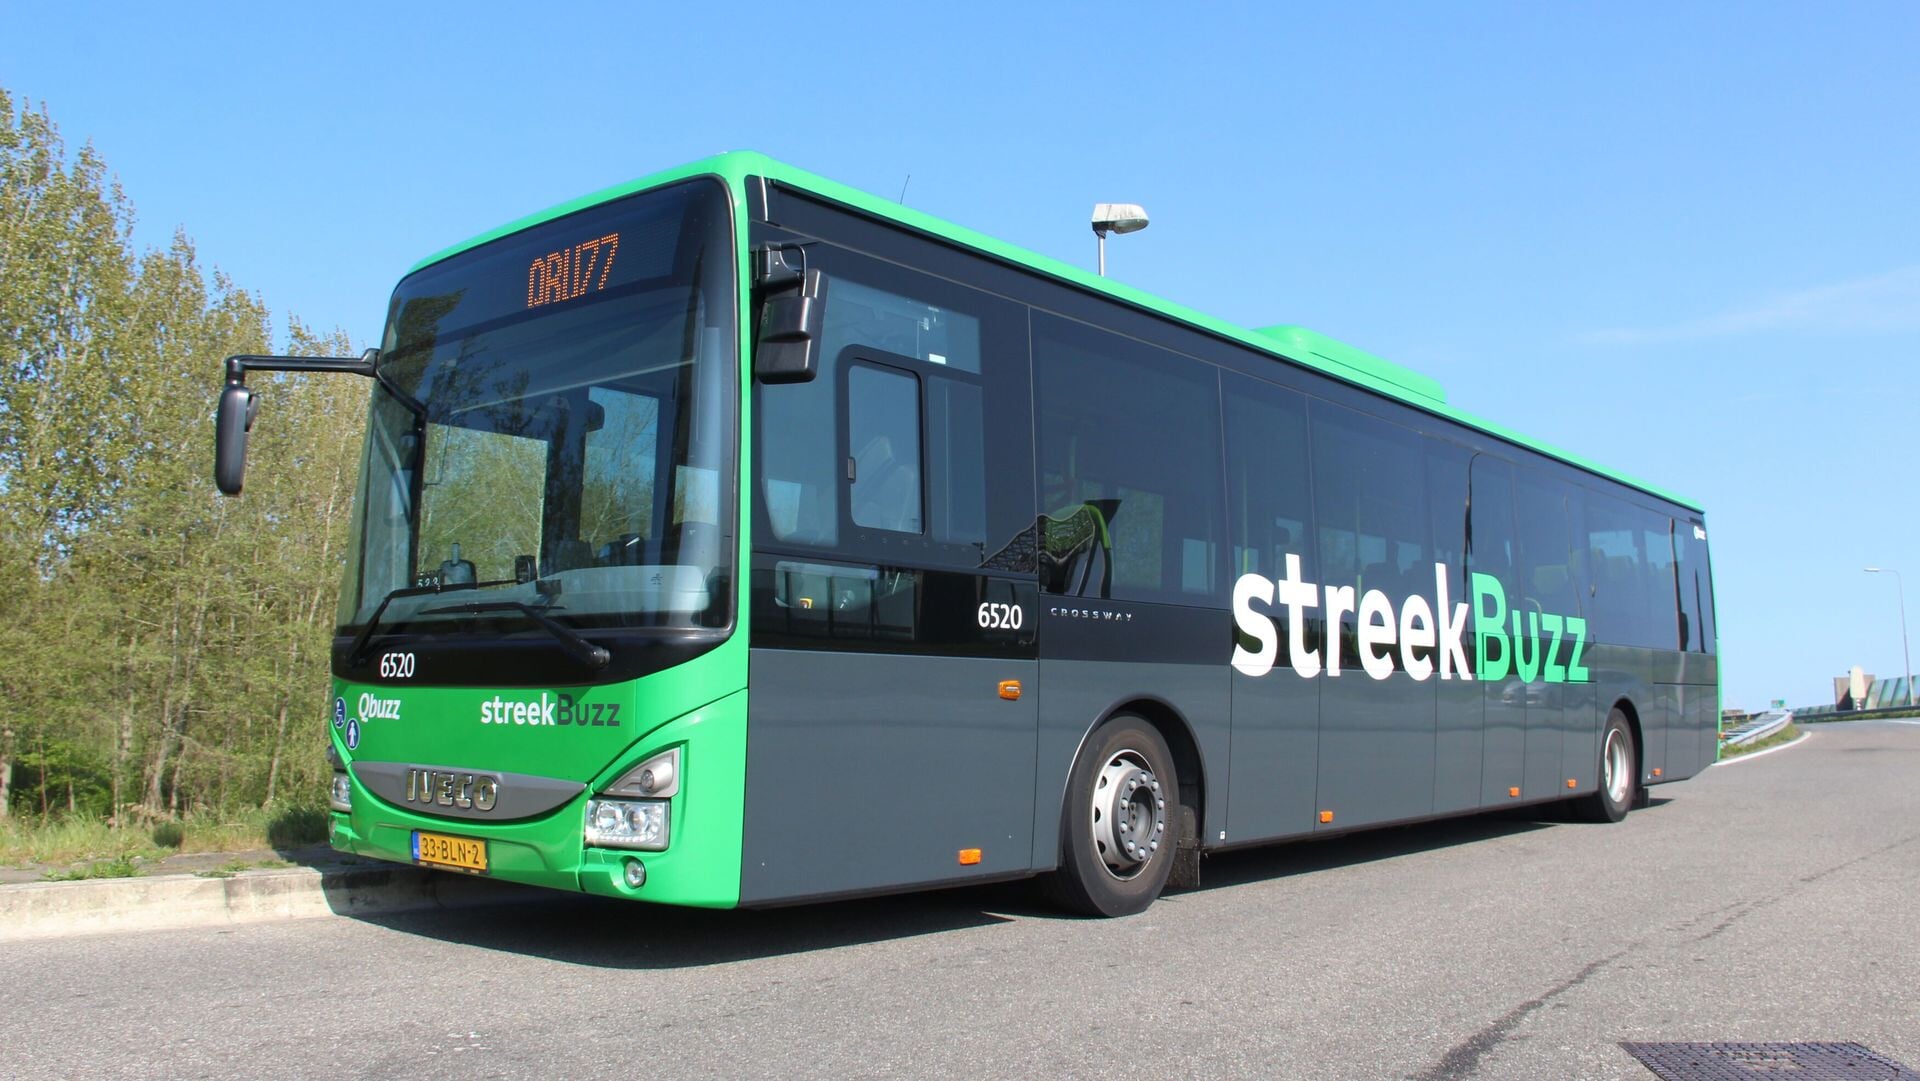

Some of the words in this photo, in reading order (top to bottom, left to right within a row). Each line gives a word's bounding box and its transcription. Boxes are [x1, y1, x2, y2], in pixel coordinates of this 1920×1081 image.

[978, 602, 1023, 630] 6520
[1050, 607, 1132, 621] CROSSWAY
[1231, 553, 1589, 684] streekBuzz
[380, 652, 415, 678] 6520
[358, 692, 402, 723] Qbuzz
[480, 692, 621, 727] streekBuzz
[406, 768, 498, 812] IVECO
[422, 837, 480, 865] 33-BLN-2
